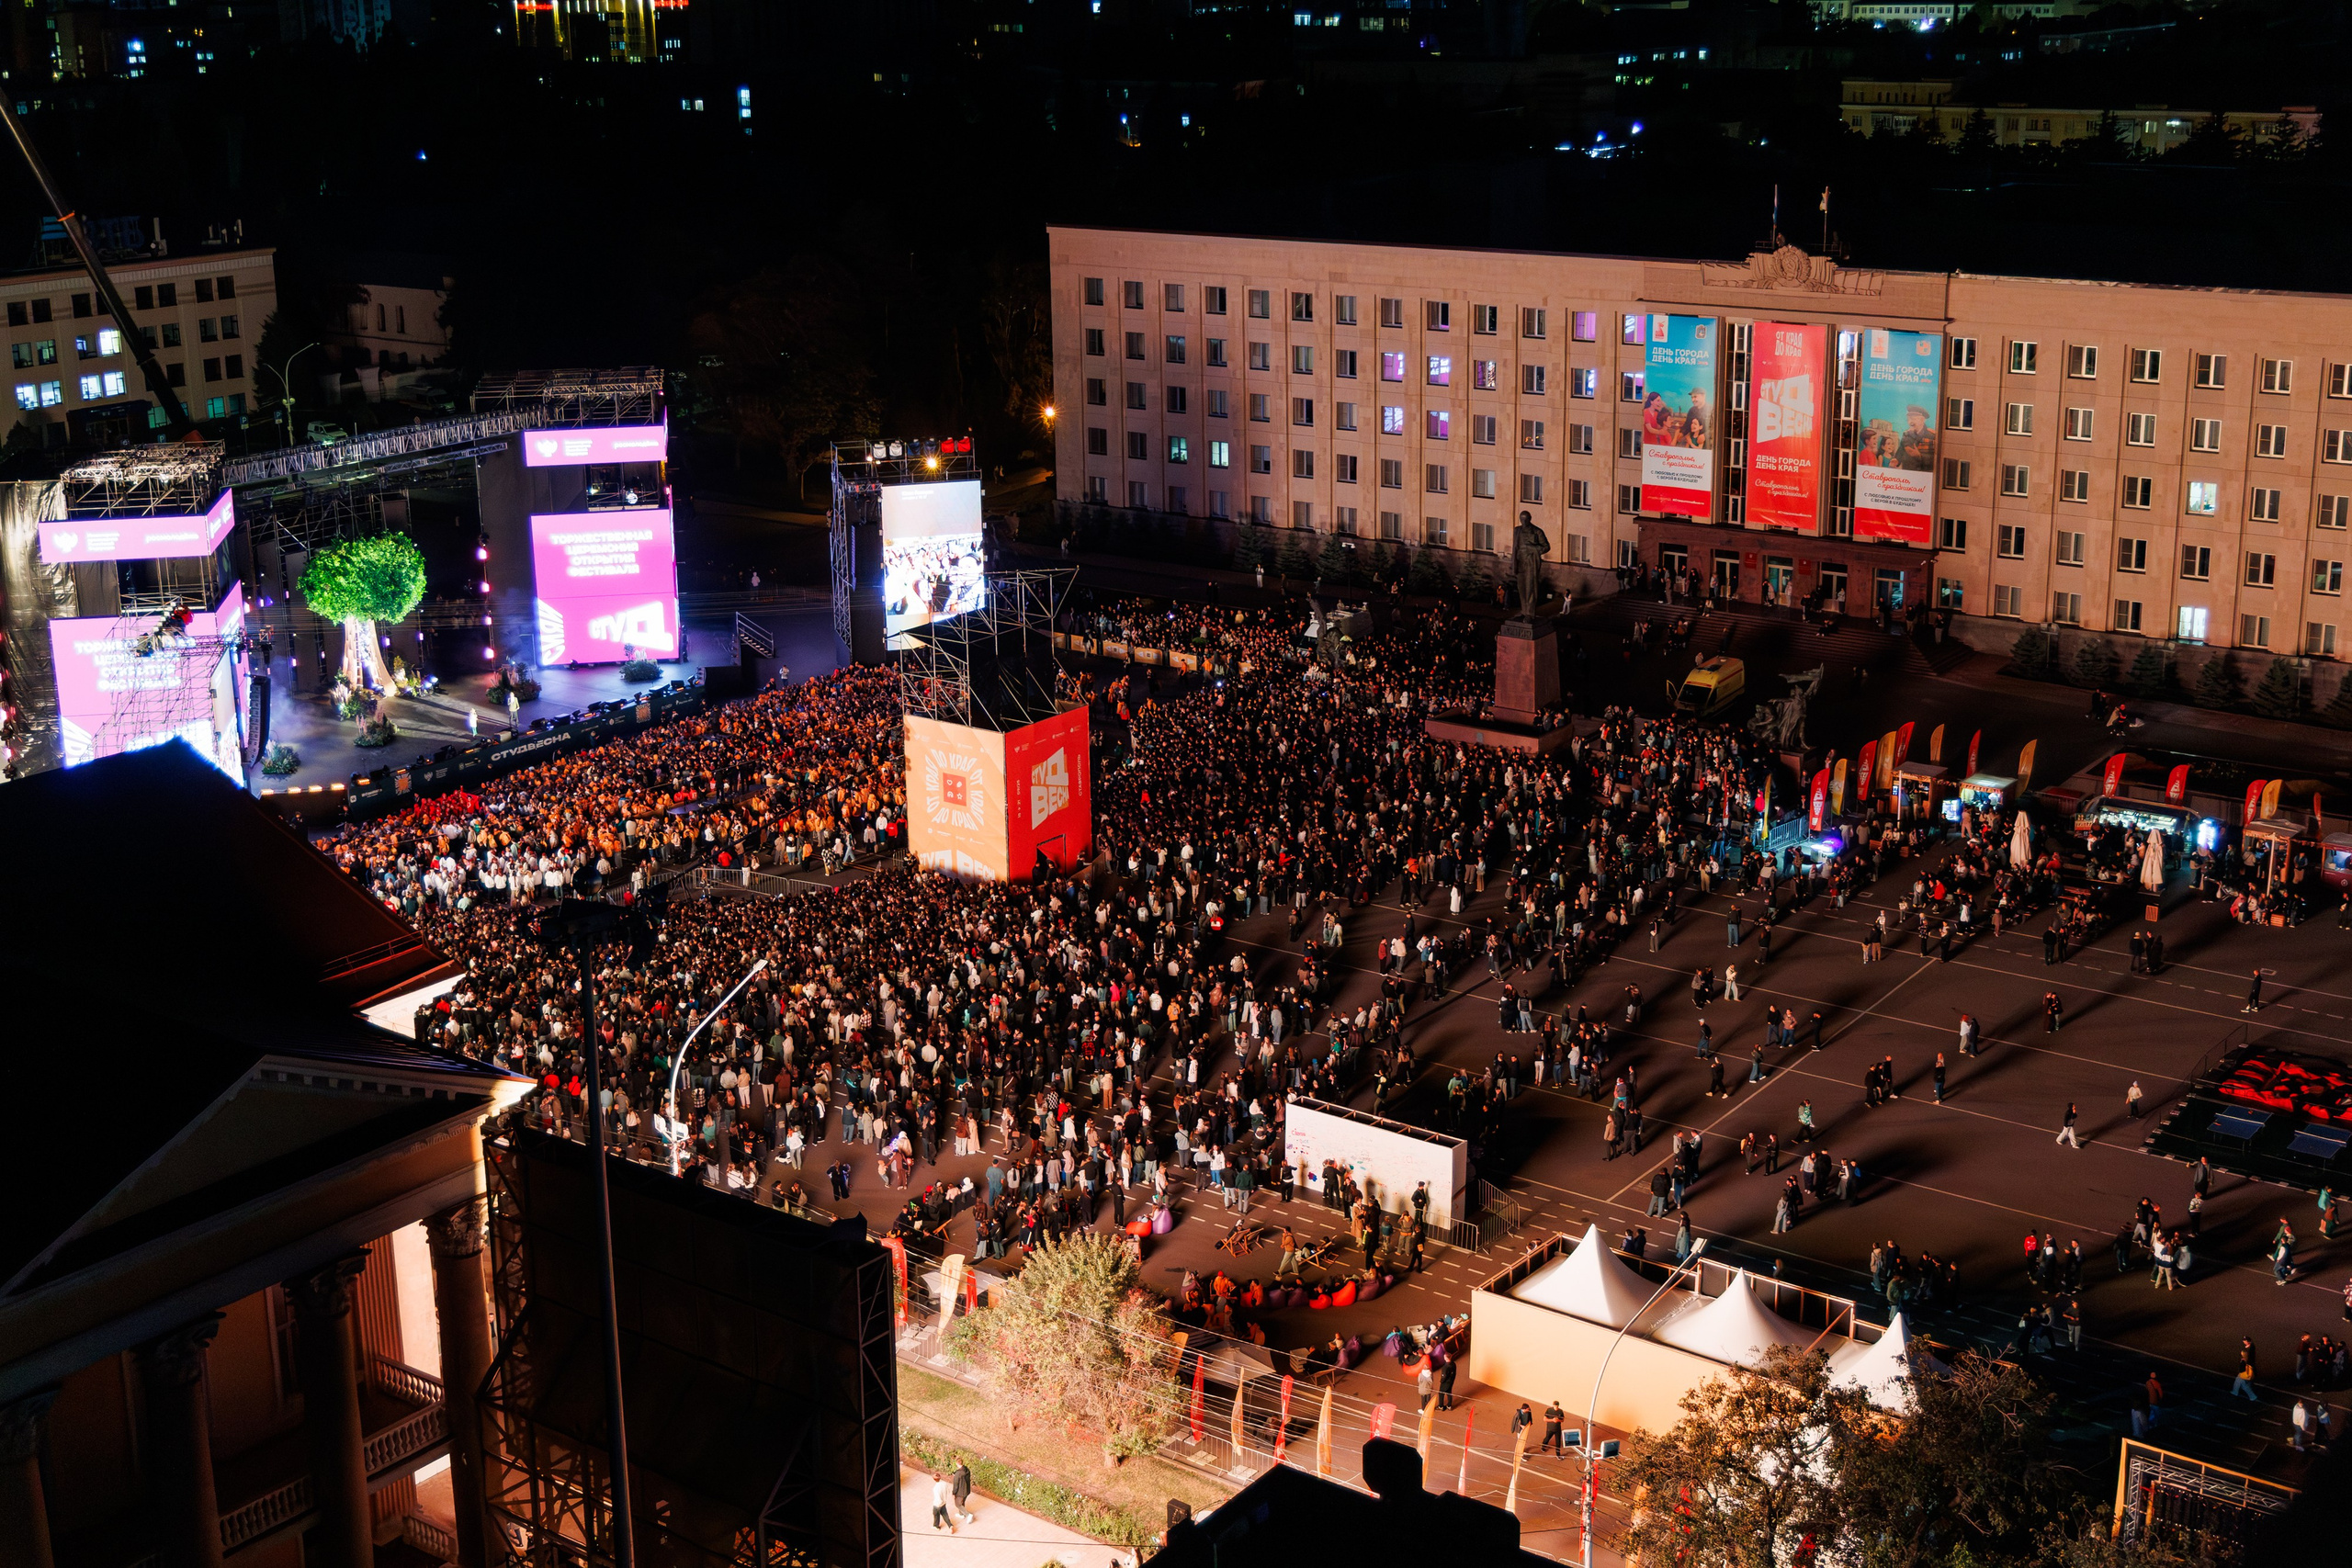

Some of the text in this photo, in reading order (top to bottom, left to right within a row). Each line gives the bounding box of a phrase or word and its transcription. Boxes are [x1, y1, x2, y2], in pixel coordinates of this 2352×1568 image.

[1776, 331, 1802, 348] ОТ КРАЯ
[1652, 347, 1709, 358] ДЕНЬ ГОРОДА
[1775, 340, 1801, 357] ДО КРАЯ
[1652, 355, 1673, 363] ДЕНЬ
[1870, 363, 1933, 376] ДЕНЬ ГОРОДА
[1870, 372, 1894, 381] ДЕНЬ
[1895, 374, 1919, 382] КРАЯ
[1760, 374, 1814, 417] СТУД
[1667, 461, 1705, 469] праздником!
[1755, 462, 1776, 470] ДЕНЬ
[1756, 454, 1811, 466] ДЕНЬ ГОРОДА
[1862, 470, 1911, 484] Ставрополь,
[1882, 483, 1926, 493] праздником!
[550, 530, 653, 545] ТОРЖЕСТВЕННАЯ
[566, 542, 639, 555] ЦЕРЕМОНИЯ
[571, 553, 635, 566] ОТКРЫТИЯ
[568, 564, 640, 577] ФЕСТИВАЛЯ
[590, 601, 674, 651] СТУД
[491, 732, 571, 761] СТУДВЕСНА
[930, 749, 977, 772] ДО КРАЯ
[1032, 746, 1069, 786] СТУД
[925, 754, 939, 791] КРАЯ
[970, 768, 983, 785] ОТ
[926, 796, 939, 813] ОТ
[970, 790, 984, 826] КРАЯ
[931, 807, 979, 831] ДО КРАЯ
